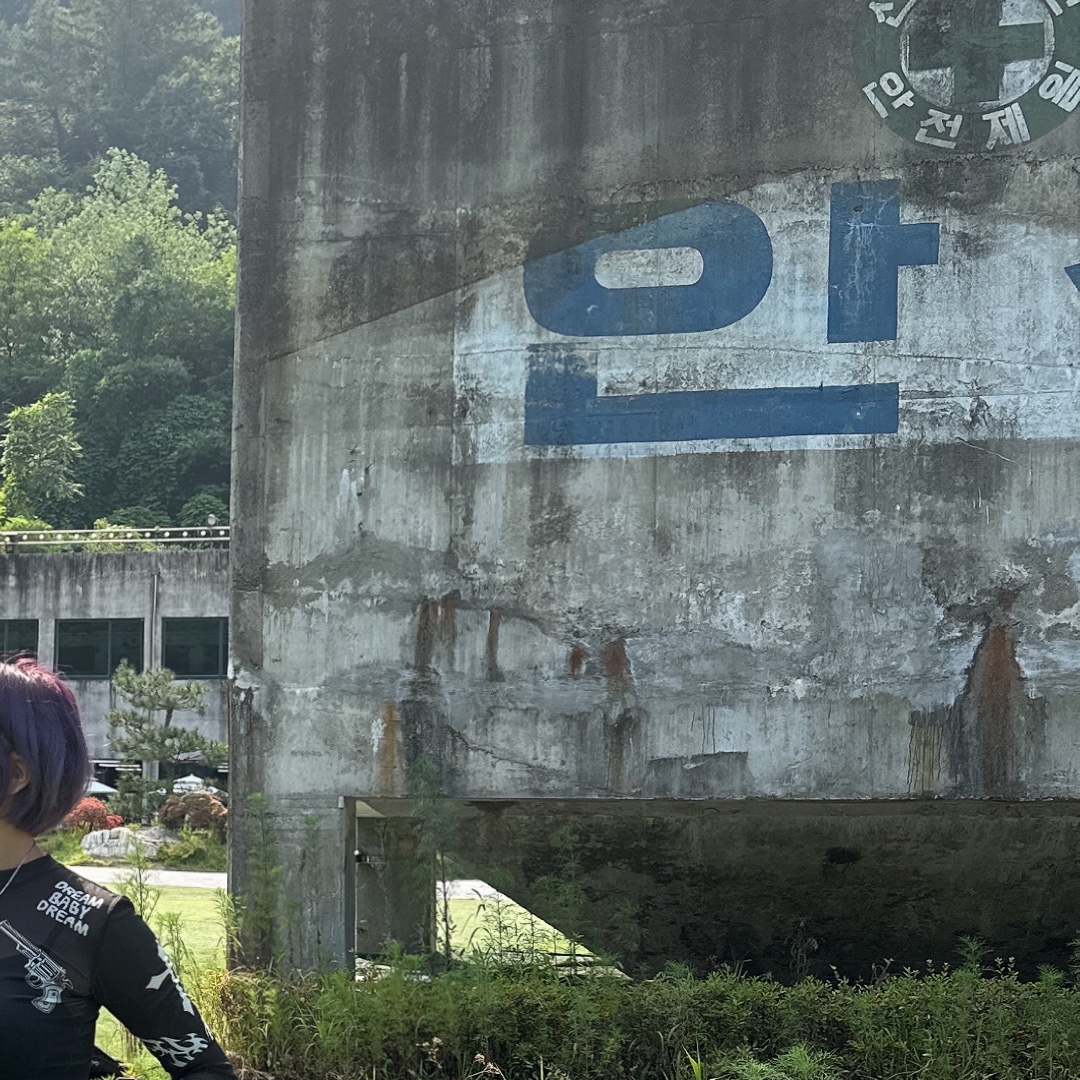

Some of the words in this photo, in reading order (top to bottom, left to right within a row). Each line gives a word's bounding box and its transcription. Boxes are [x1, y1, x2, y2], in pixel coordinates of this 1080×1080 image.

[524, 179, 1080, 445] 안
[48, 892, 91, 919] BABY
[54, 881, 104, 909] DREAM
[36, 900, 89, 936] DREAM
